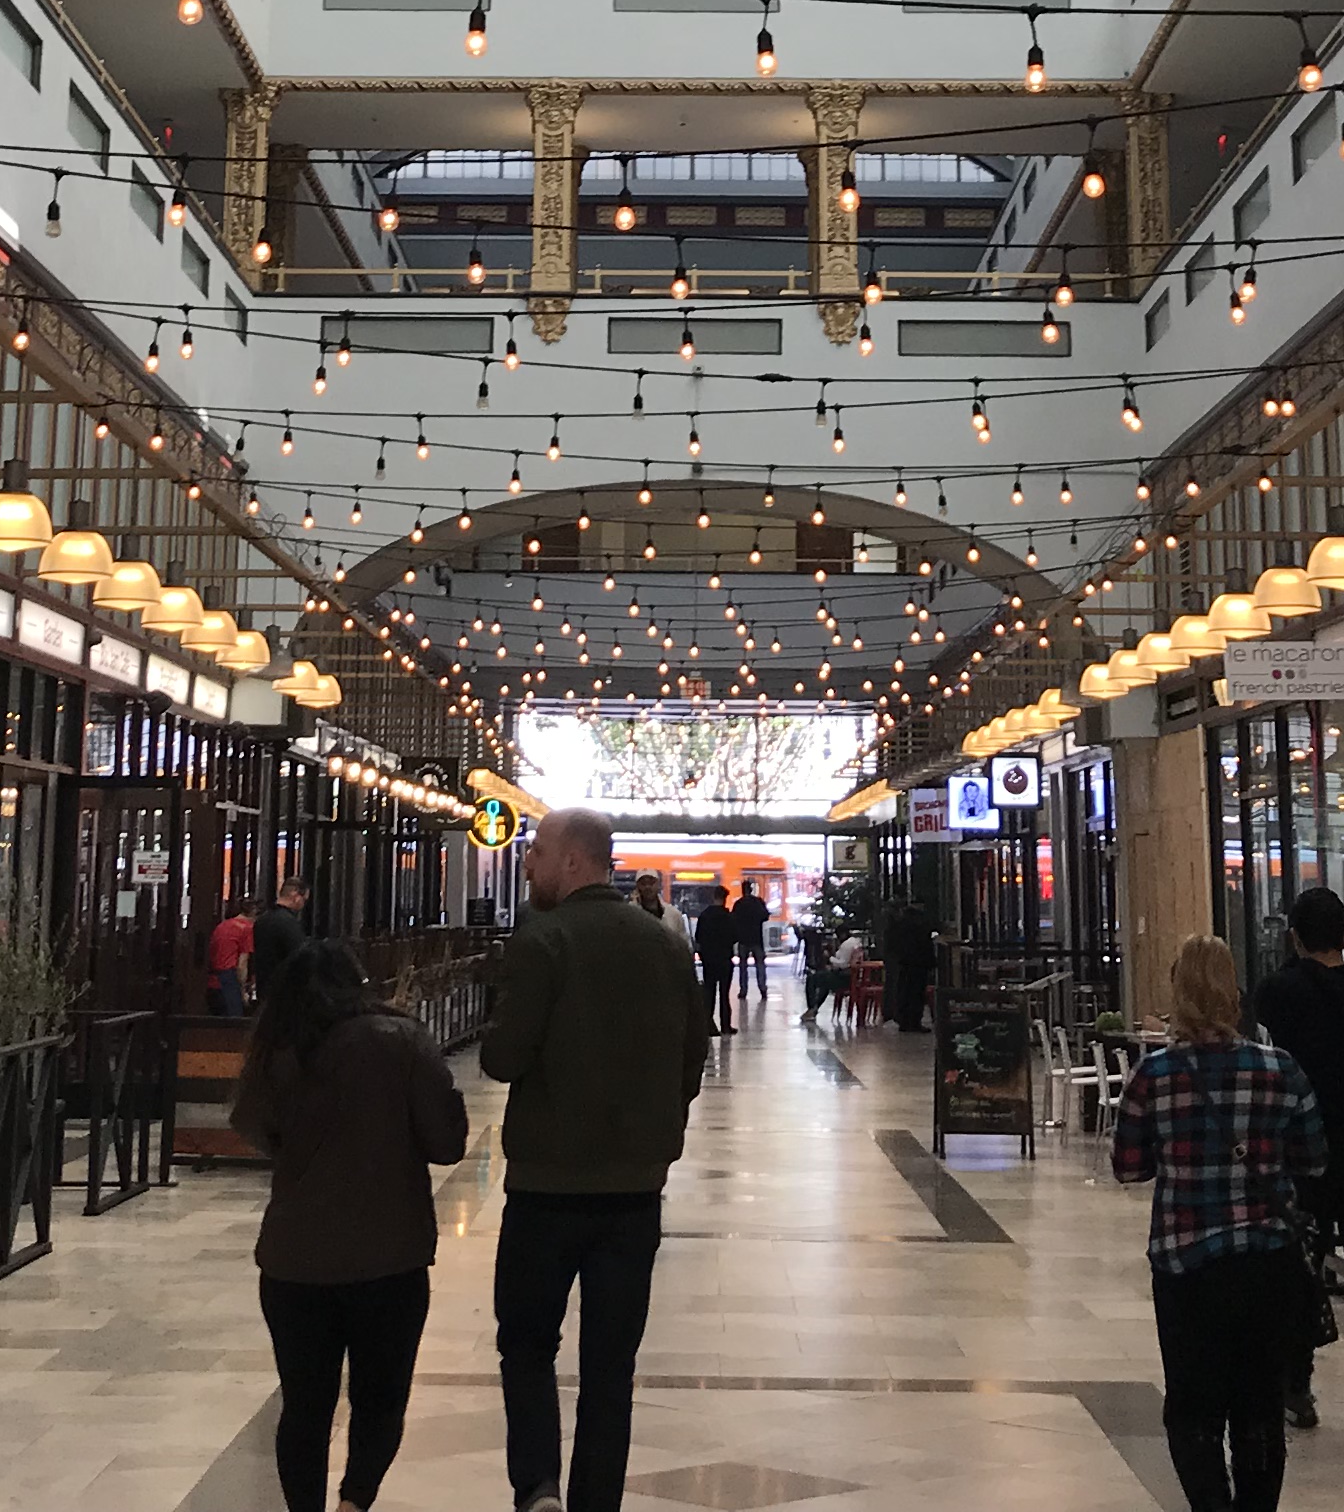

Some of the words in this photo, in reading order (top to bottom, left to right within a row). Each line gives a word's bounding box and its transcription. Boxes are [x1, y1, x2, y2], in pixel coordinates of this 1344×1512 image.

[1228, 645, 1247, 663] le
[1232, 681, 1283, 698] french
[914, 814, 947, 833] GRIL
